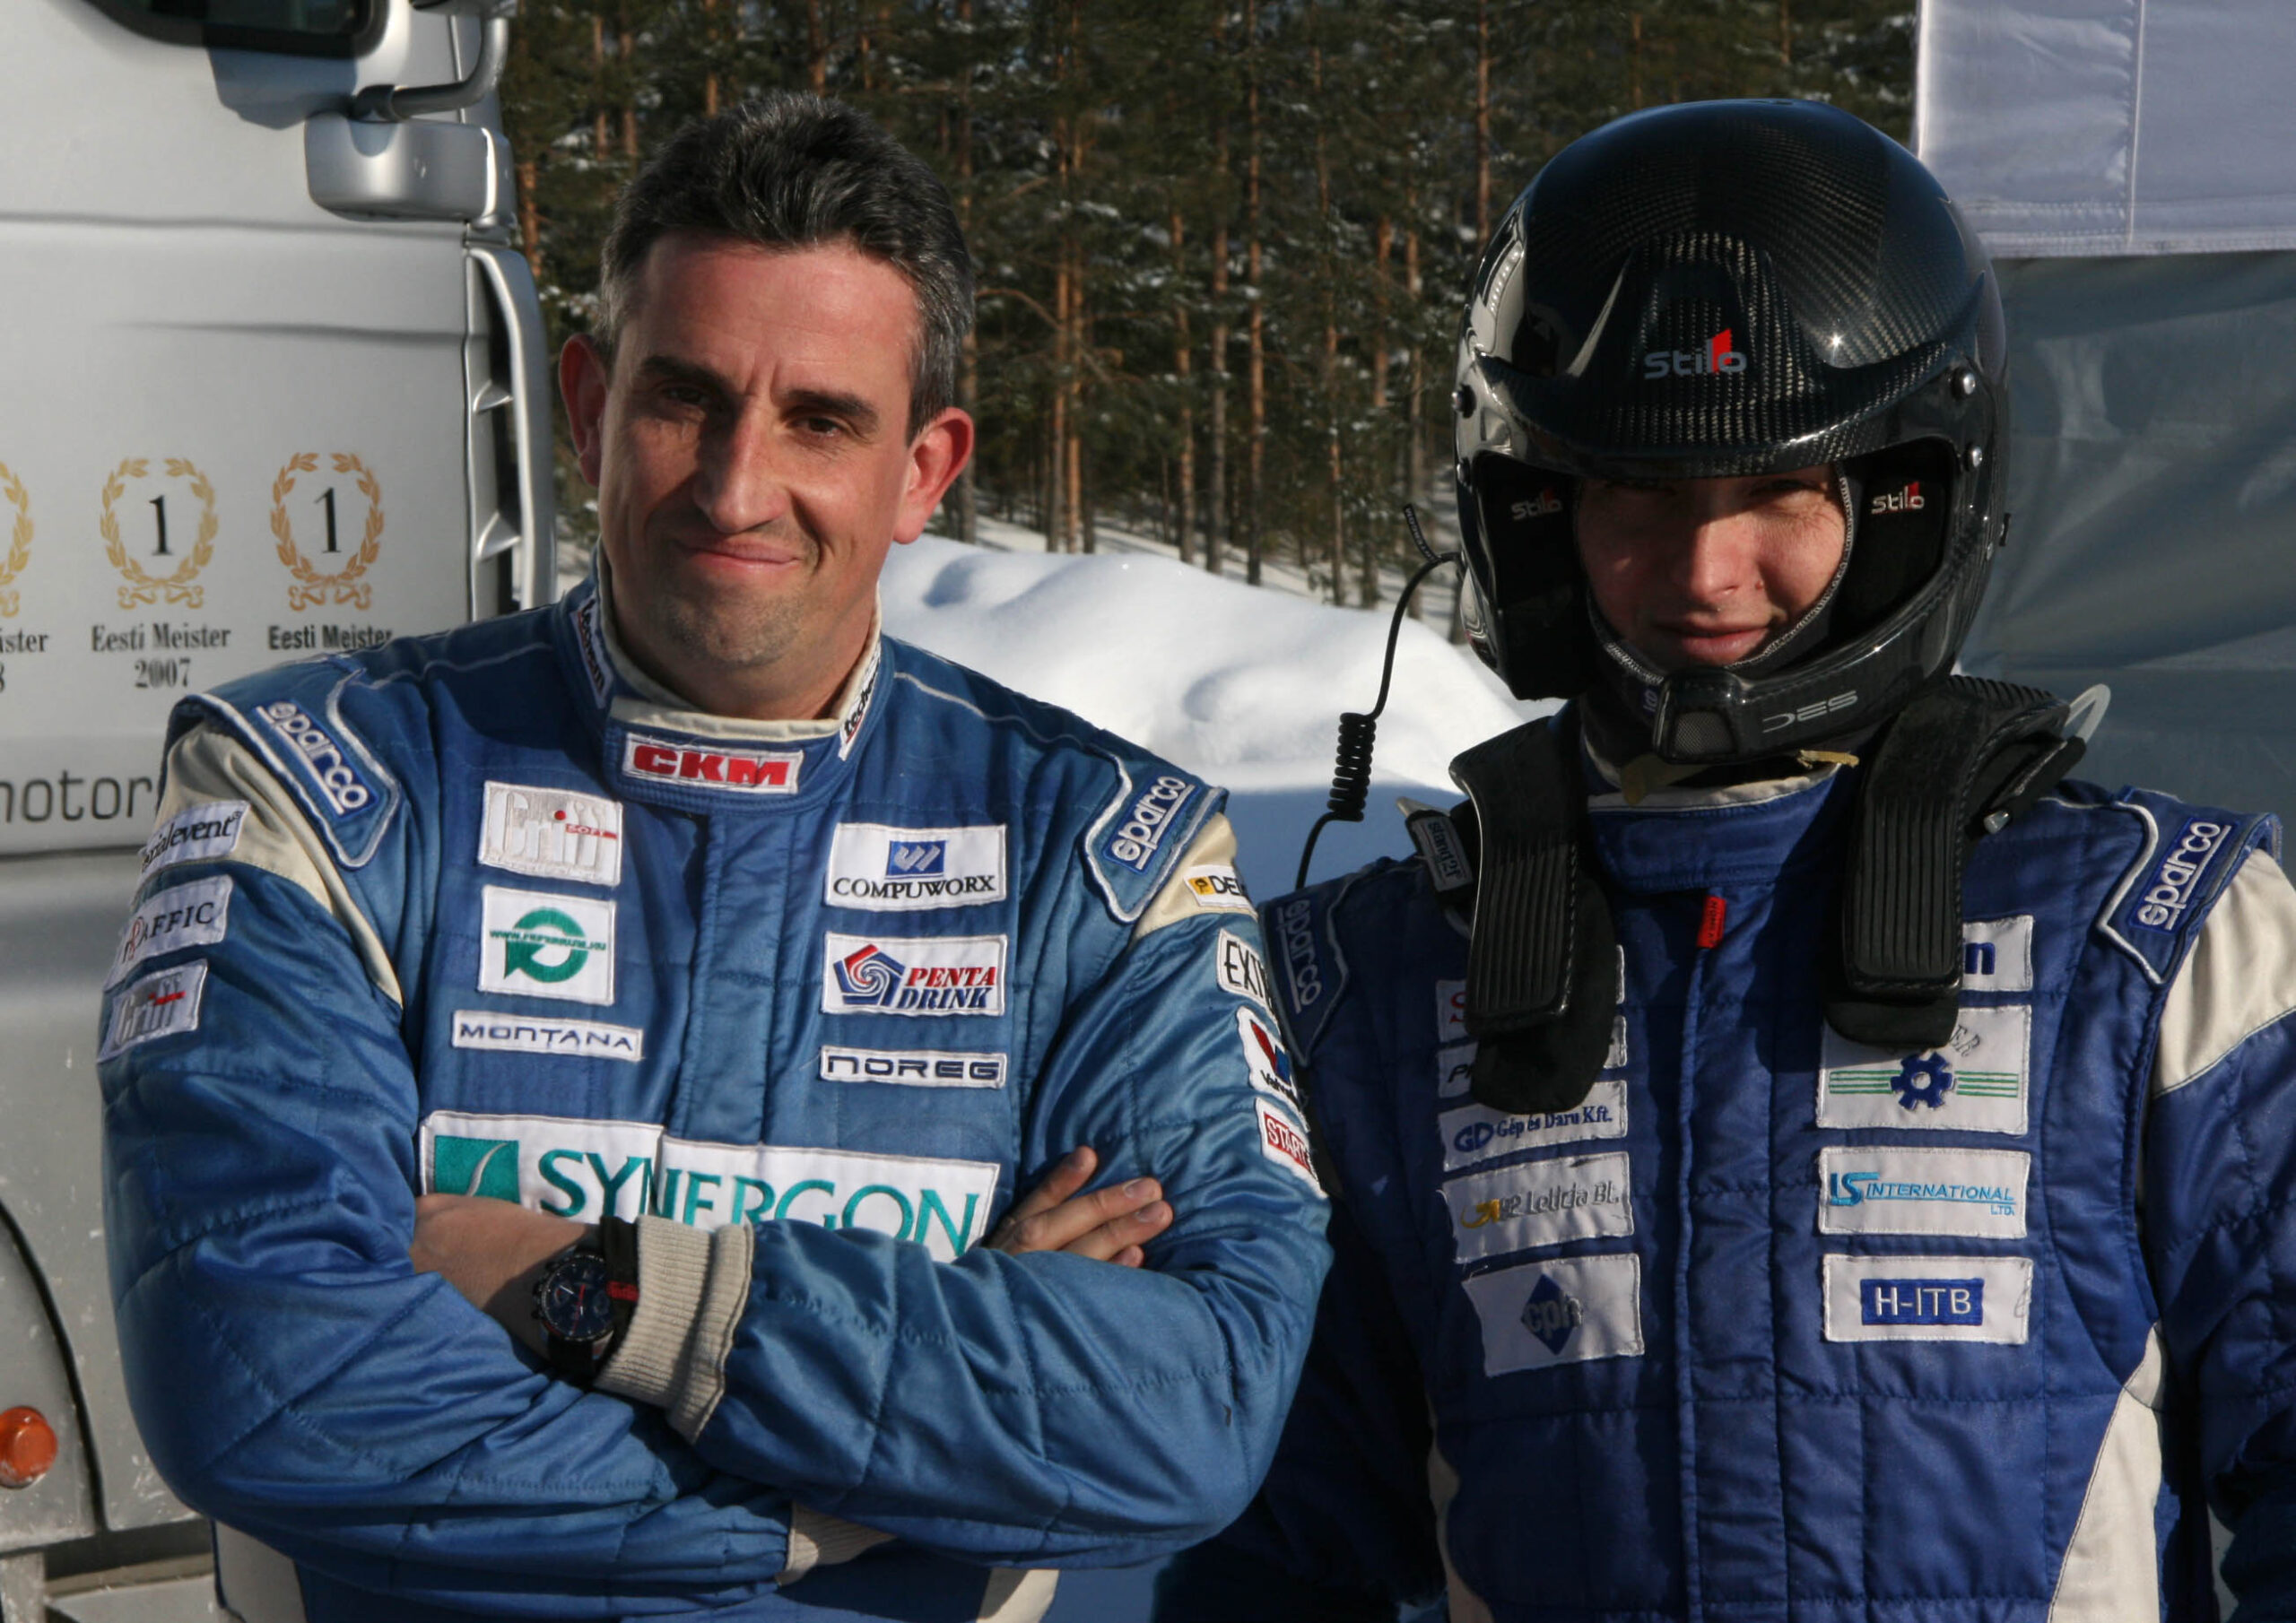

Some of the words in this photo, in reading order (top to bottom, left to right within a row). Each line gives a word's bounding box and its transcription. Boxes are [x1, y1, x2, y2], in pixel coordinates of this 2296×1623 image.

[1644, 339, 1747, 378] stilo
[1872, 485, 1925, 514] stilo
[149, 495, 173, 556] 1
[314, 487, 342, 553] 1
[0, 626, 48, 653] ister
[91, 623, 145, 653] Eesti
[152, 622, 231, 649] Meister
[267, 625, 316, 650] Eesti
[322, 624, 392, 649] Meister
[135, 656, 191, 689] 2007
[265, 701, 369, 811] sparco
[633, 744, 791, 786] CKM
[1111, 776, 1188, 866] sparco
[833, 875, 996, 899] COMPUWORX
[2137, 821, 2221, 926] sparco
[1277, 899, 1323, 1007] sparco
[907, 966, 997, 987] PENTA
[897, 987, 993, 1010] DRINK
[459, 1021, 635, 1052] MONTANA
[827, 1055, 1000, 1081] NOREG
[1545, 1113, 1578, 1129] Daru
[1583, 1105, 1613, 1124] Kft.
[538, 1148, 978, 1256] SYNERGON
[1866, 1182, 2014, 1201] INTERNATIONAL
[1990, 1205, 2015, 1216] LTD.
[1874, 1286, 1972, 1317] H-ITB
